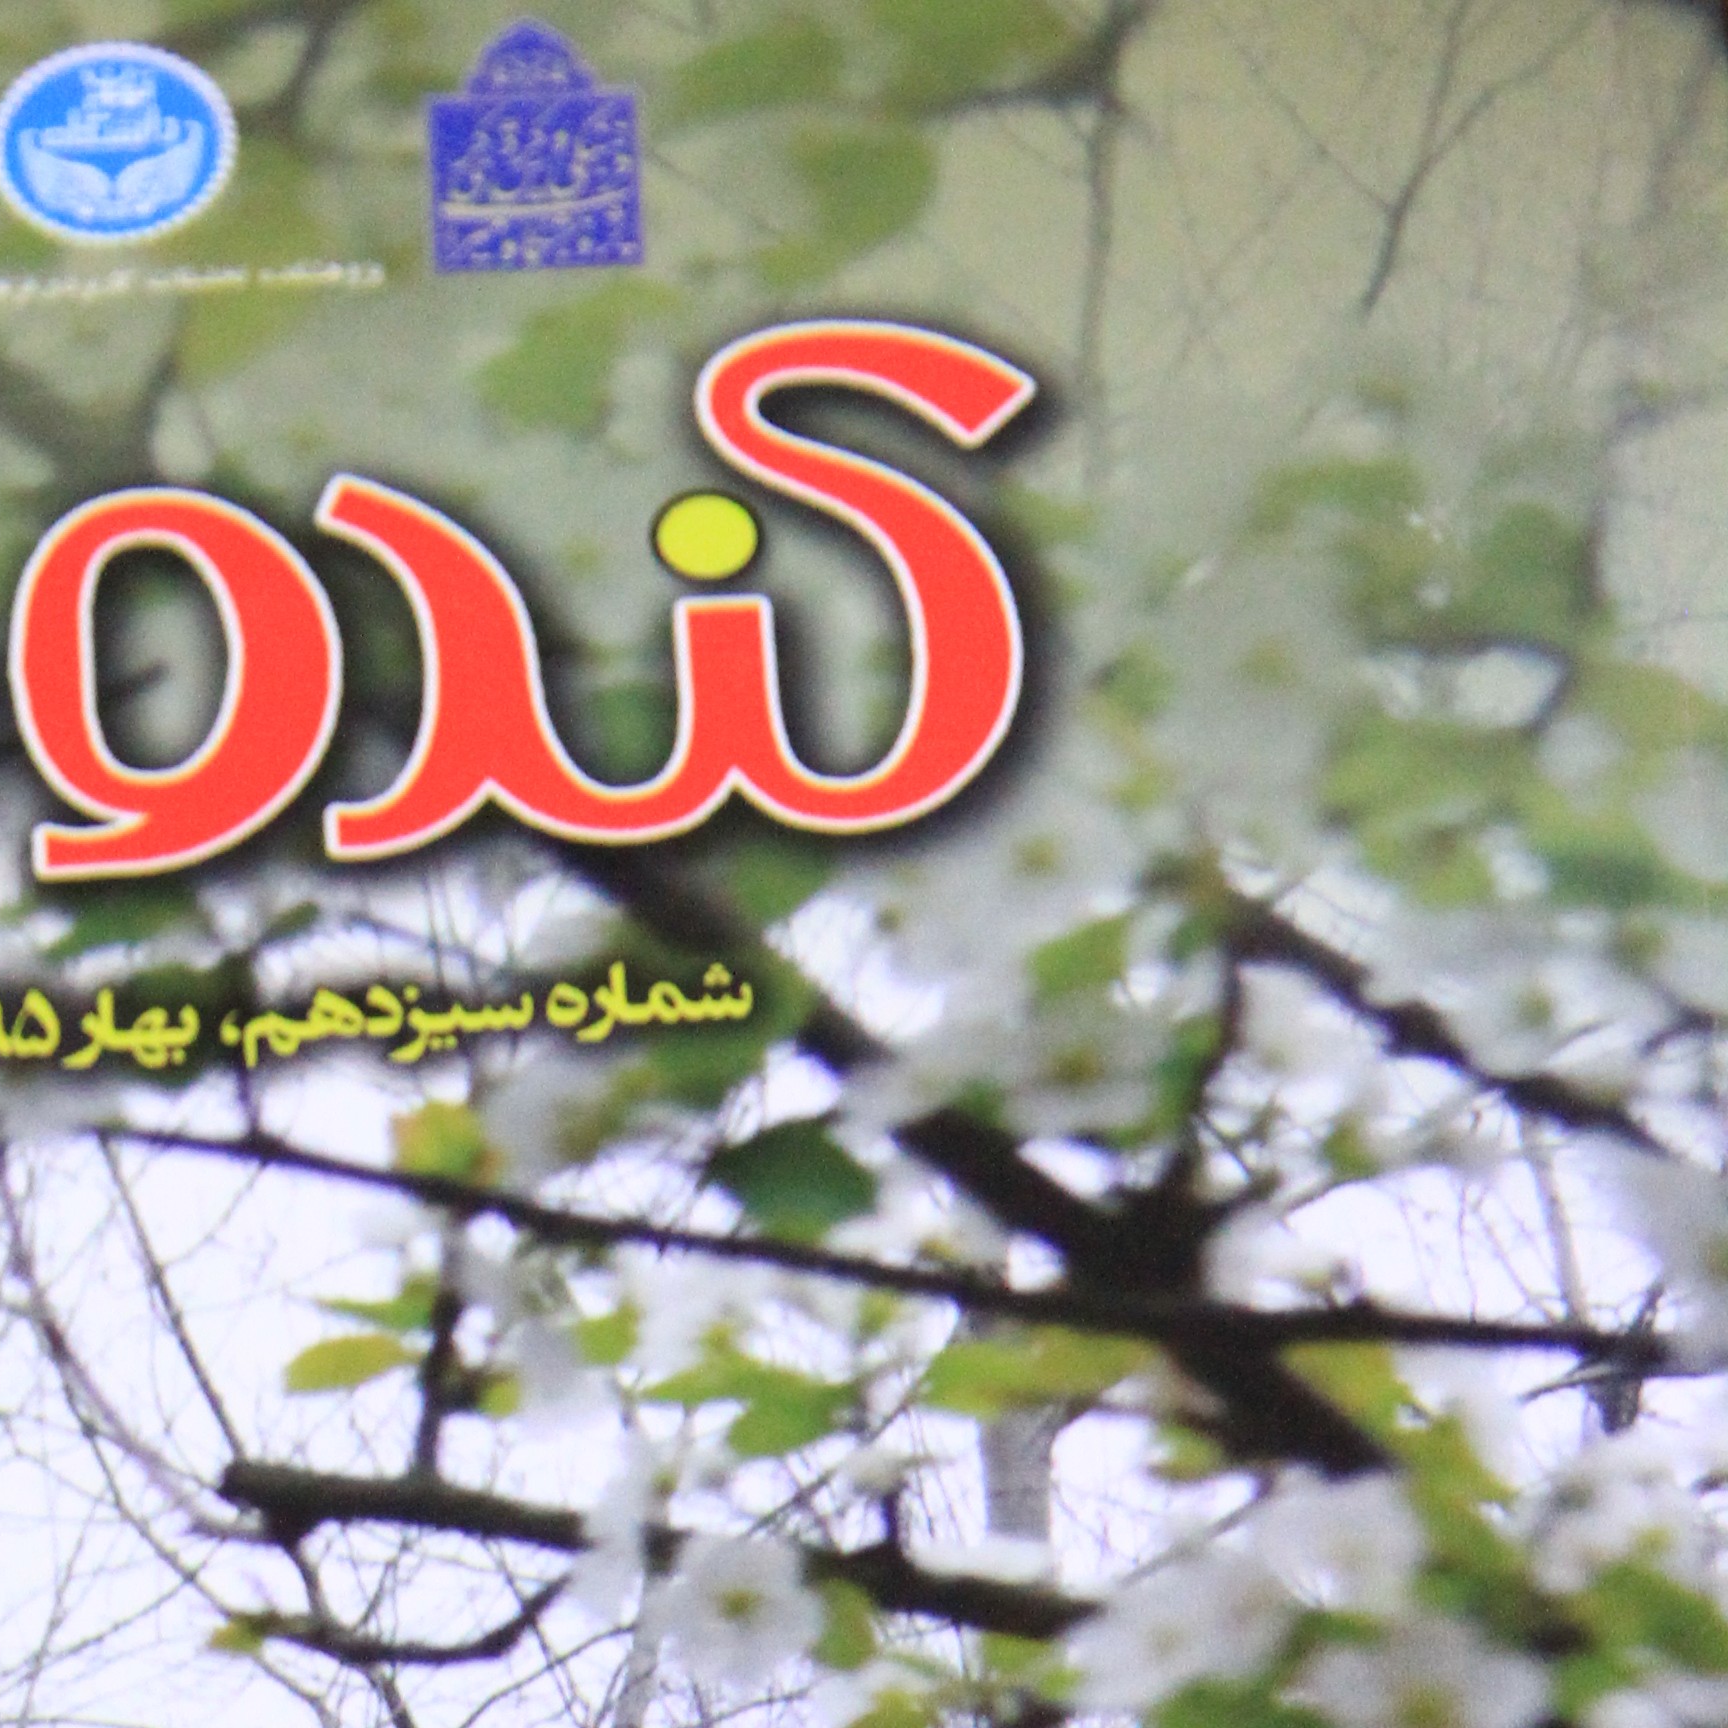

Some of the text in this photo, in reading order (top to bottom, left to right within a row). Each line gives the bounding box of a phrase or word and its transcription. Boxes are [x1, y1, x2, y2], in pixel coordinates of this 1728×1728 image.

[61, 986, 202, 1070] بهار
[219, 982, 536, 1069] سیزدهم،
[544, 960, 755, 1044] شماره
